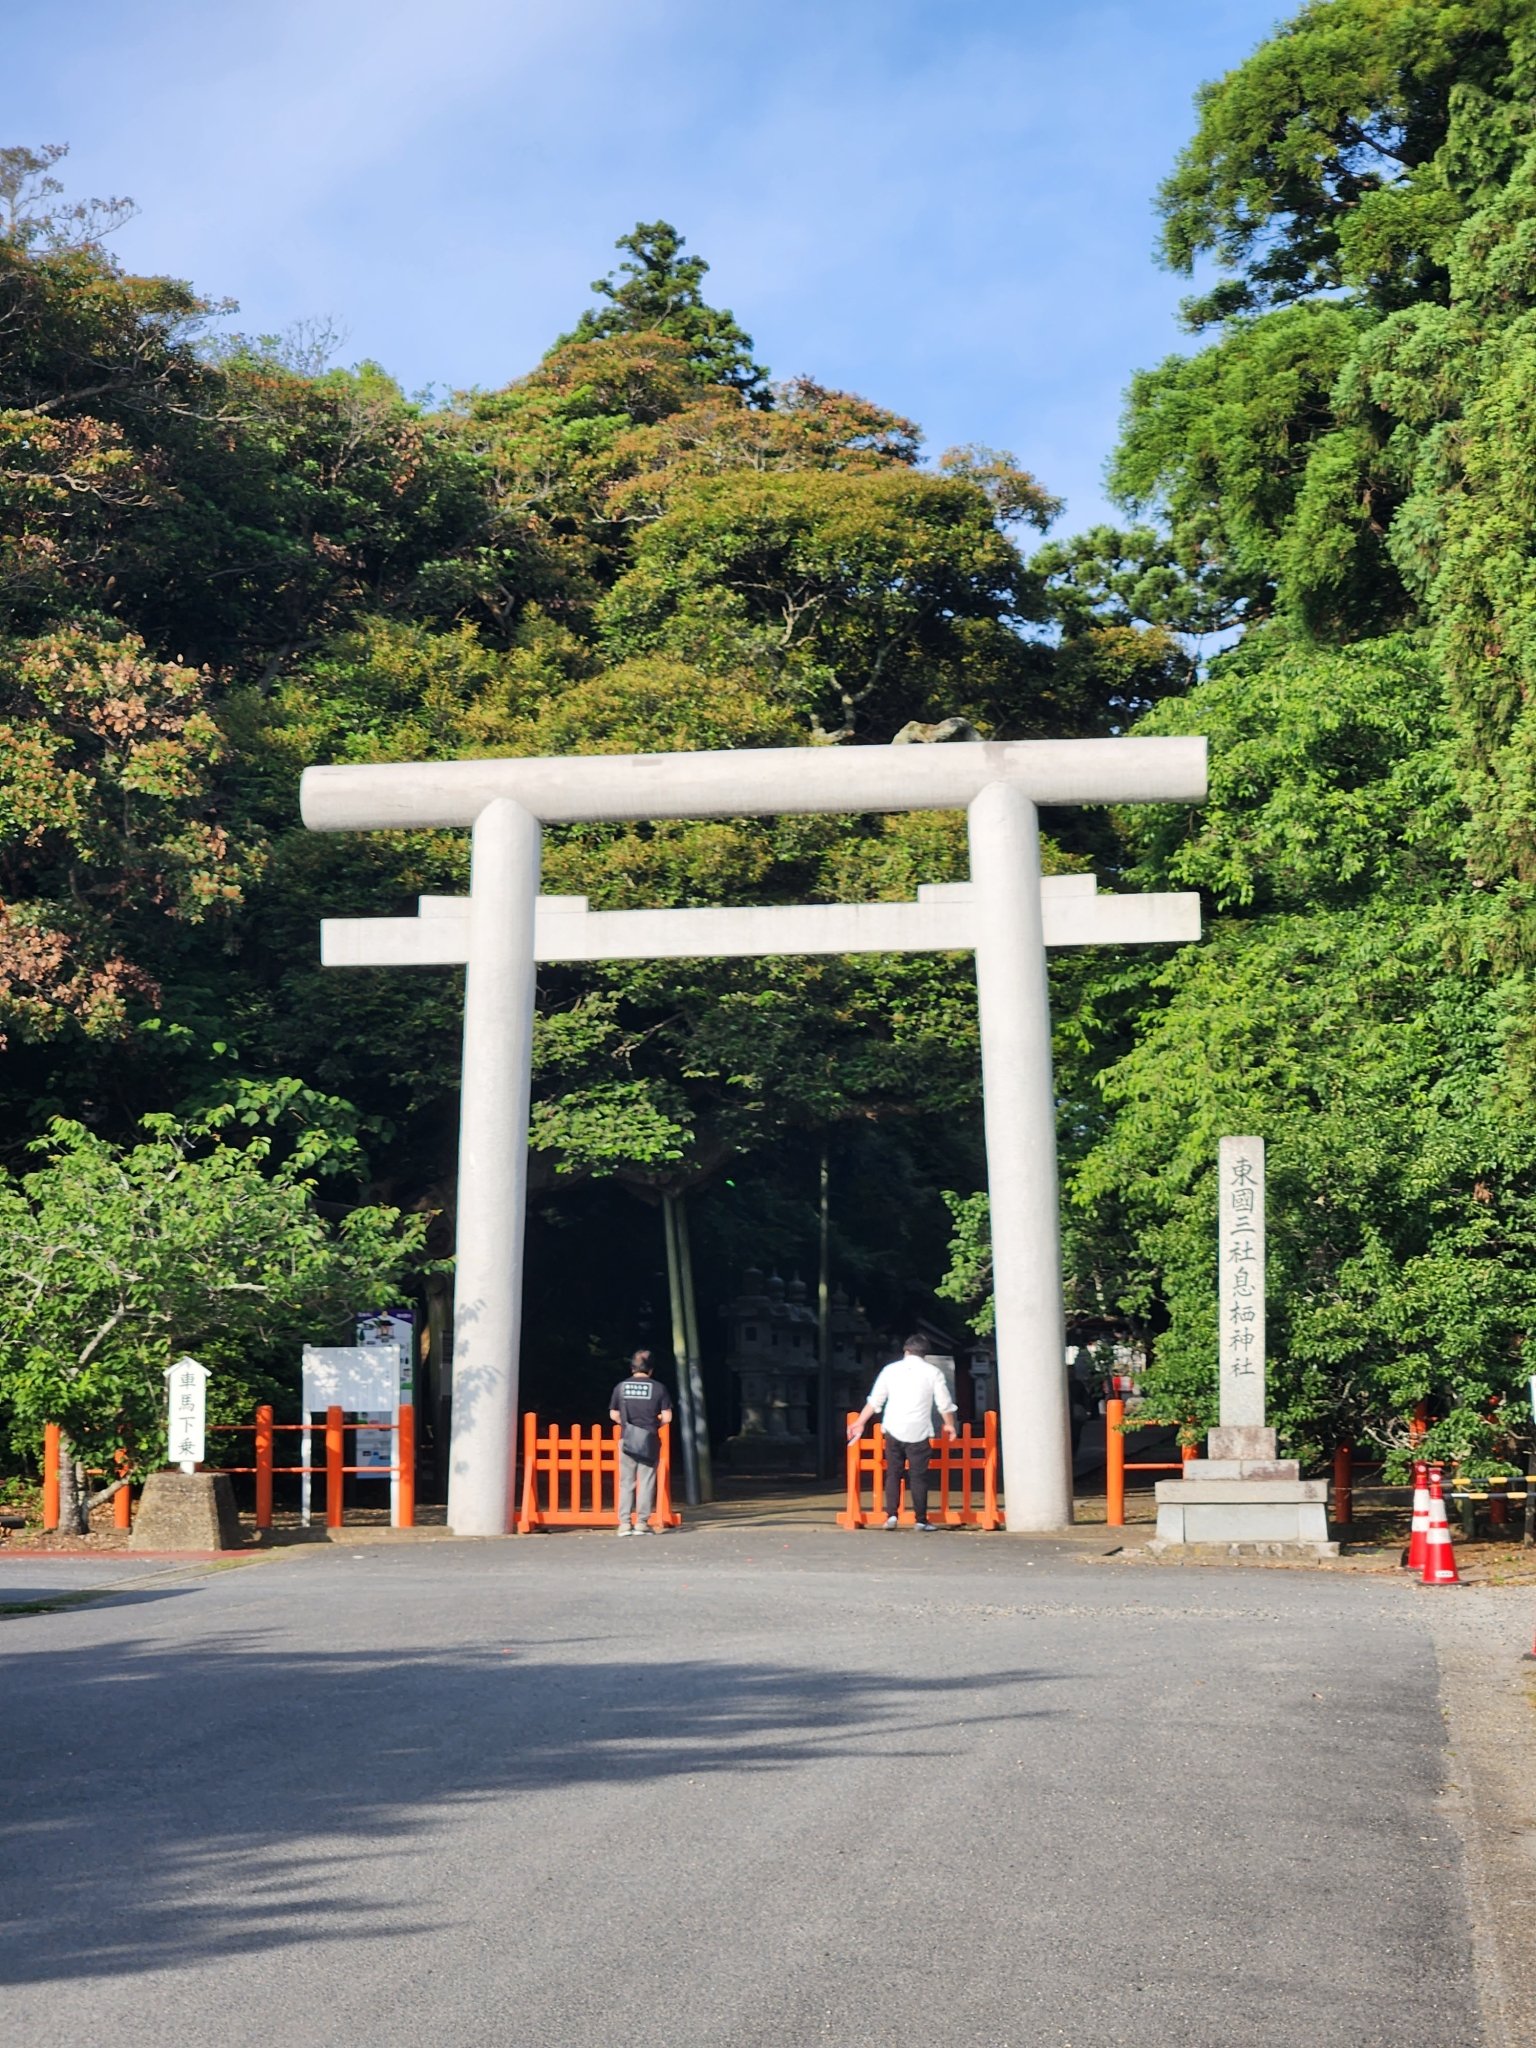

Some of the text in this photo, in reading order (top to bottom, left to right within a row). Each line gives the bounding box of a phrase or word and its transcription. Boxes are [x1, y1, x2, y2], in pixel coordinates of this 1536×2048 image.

[1228, 1156, 1258, 1377] 東國三社息栖神社
